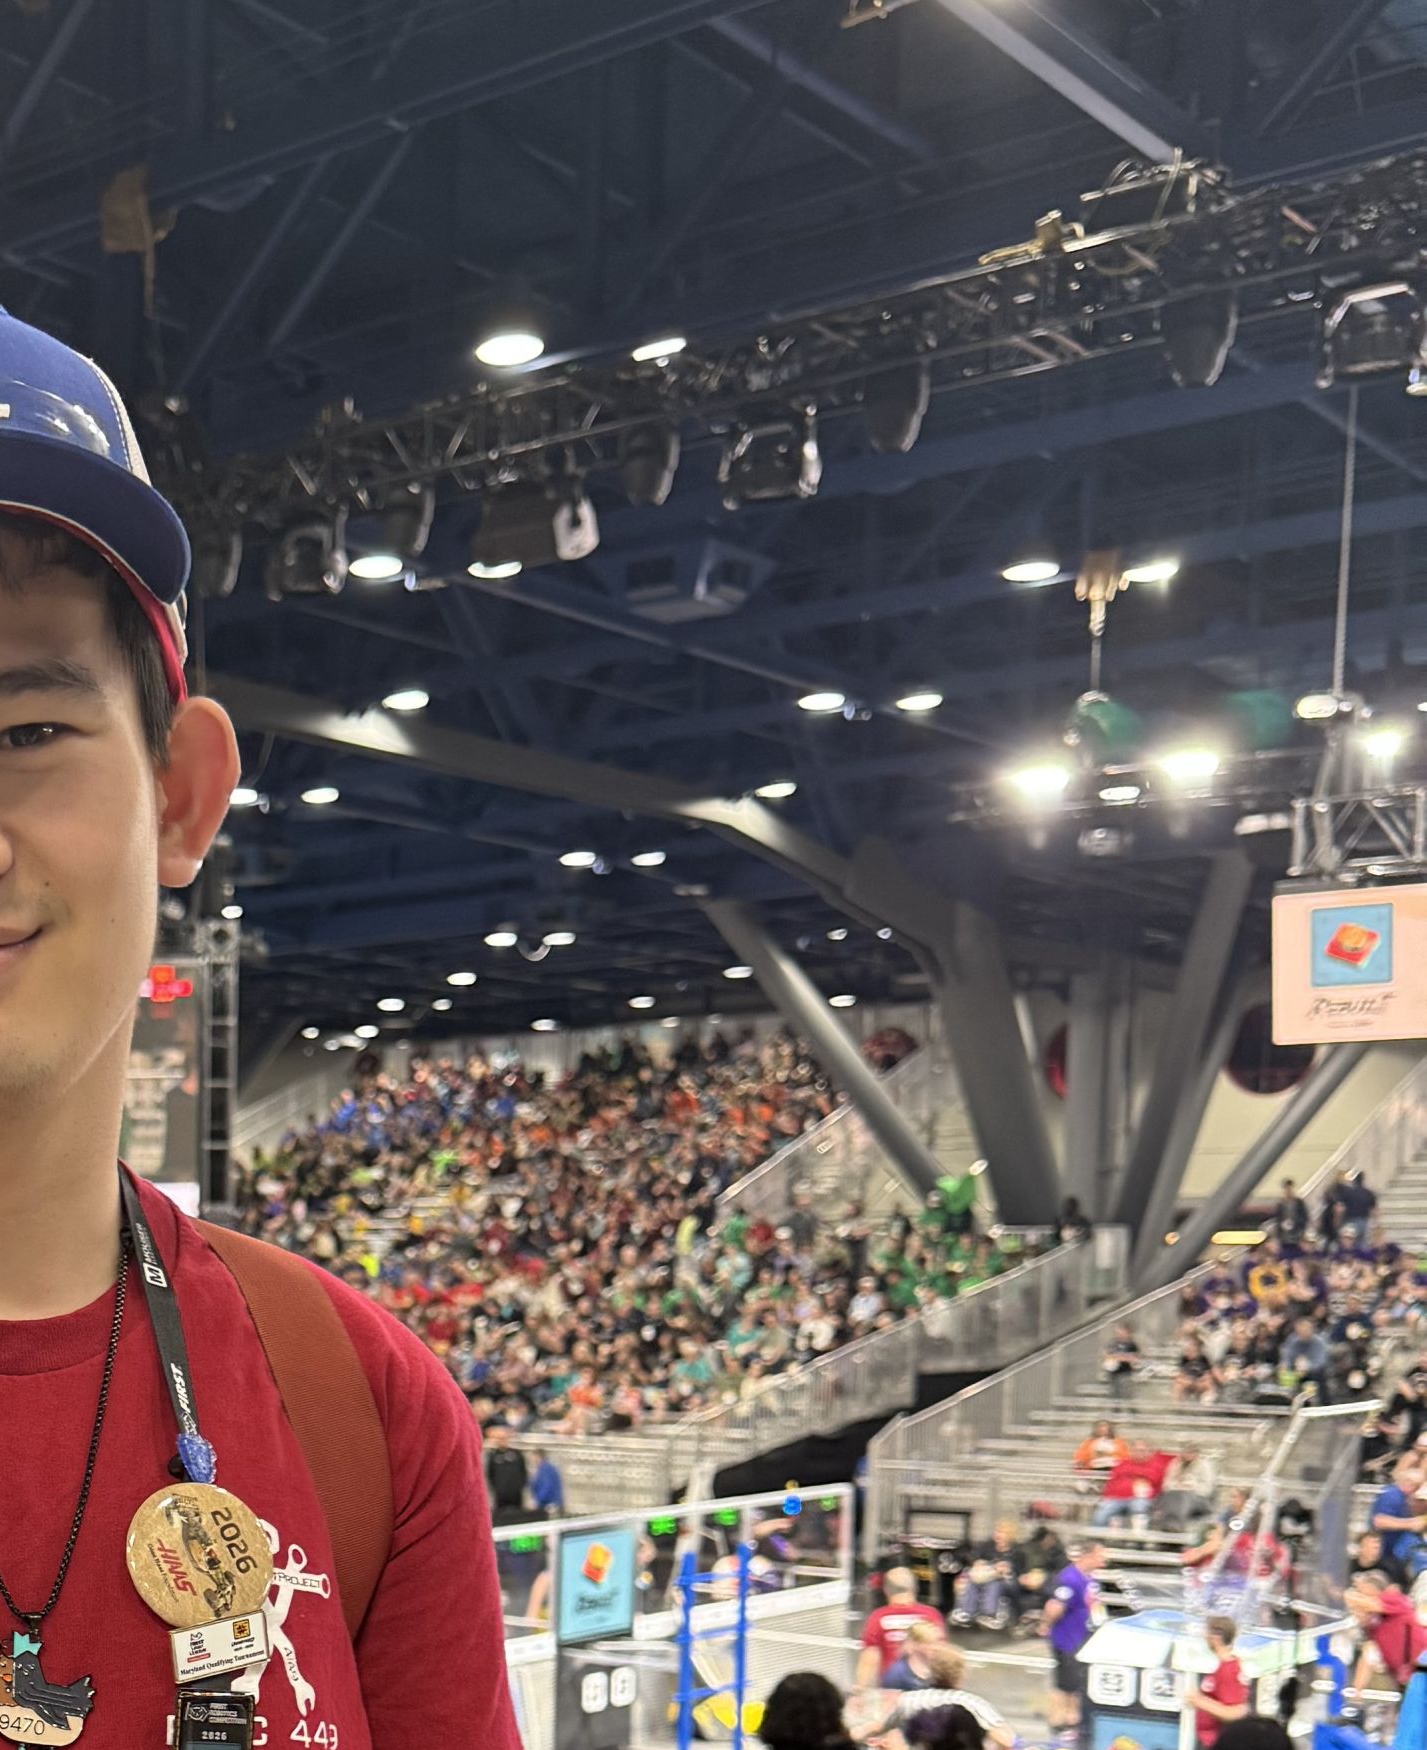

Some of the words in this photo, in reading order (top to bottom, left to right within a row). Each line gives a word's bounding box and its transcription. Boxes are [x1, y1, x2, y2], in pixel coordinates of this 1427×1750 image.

[170, 1363, 192, 1414] FIRST
[211, 1507, 258, 1574] 2026
[180, 1663, 205, 1676] Maryland
